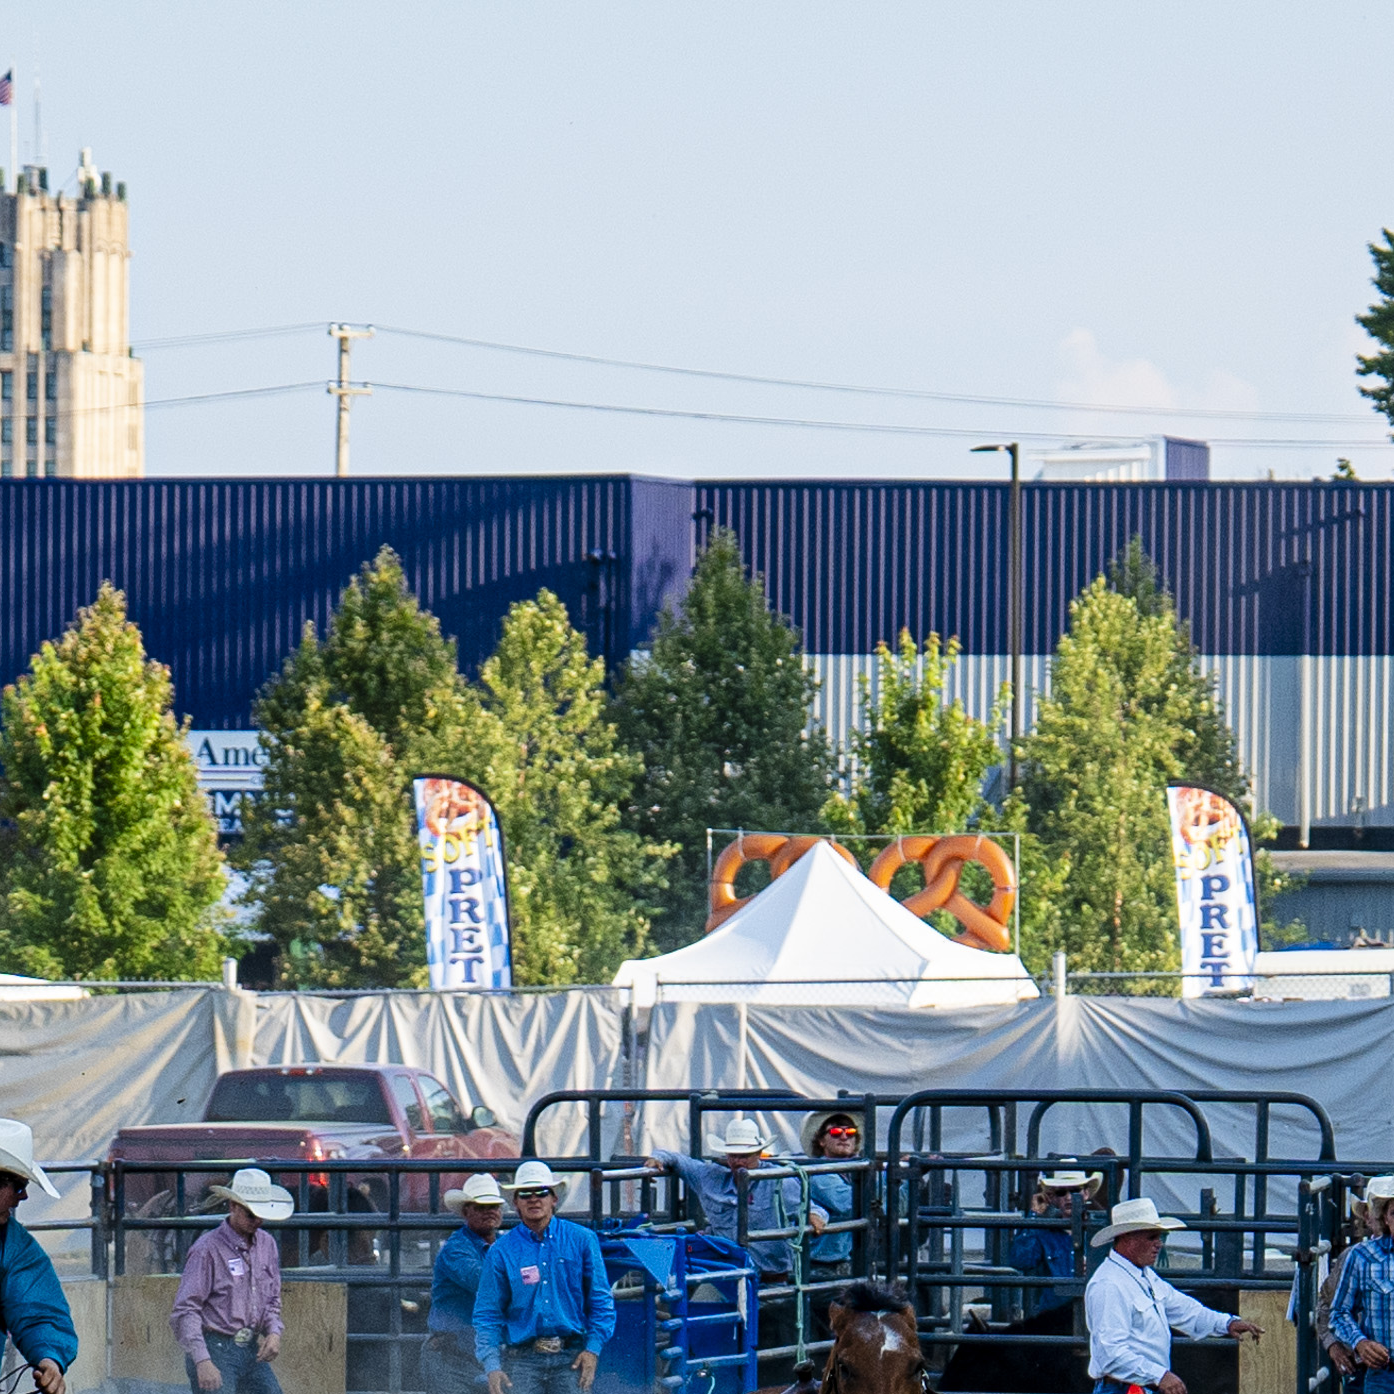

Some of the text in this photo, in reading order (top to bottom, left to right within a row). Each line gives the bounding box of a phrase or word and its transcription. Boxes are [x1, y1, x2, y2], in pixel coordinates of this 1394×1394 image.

[197, 736, 270, 767] Ame
[420, 817, 494, 873] SOFT
[449, 867, 484, 984] PRET
[1199, 874, 1231, 988] PRET
